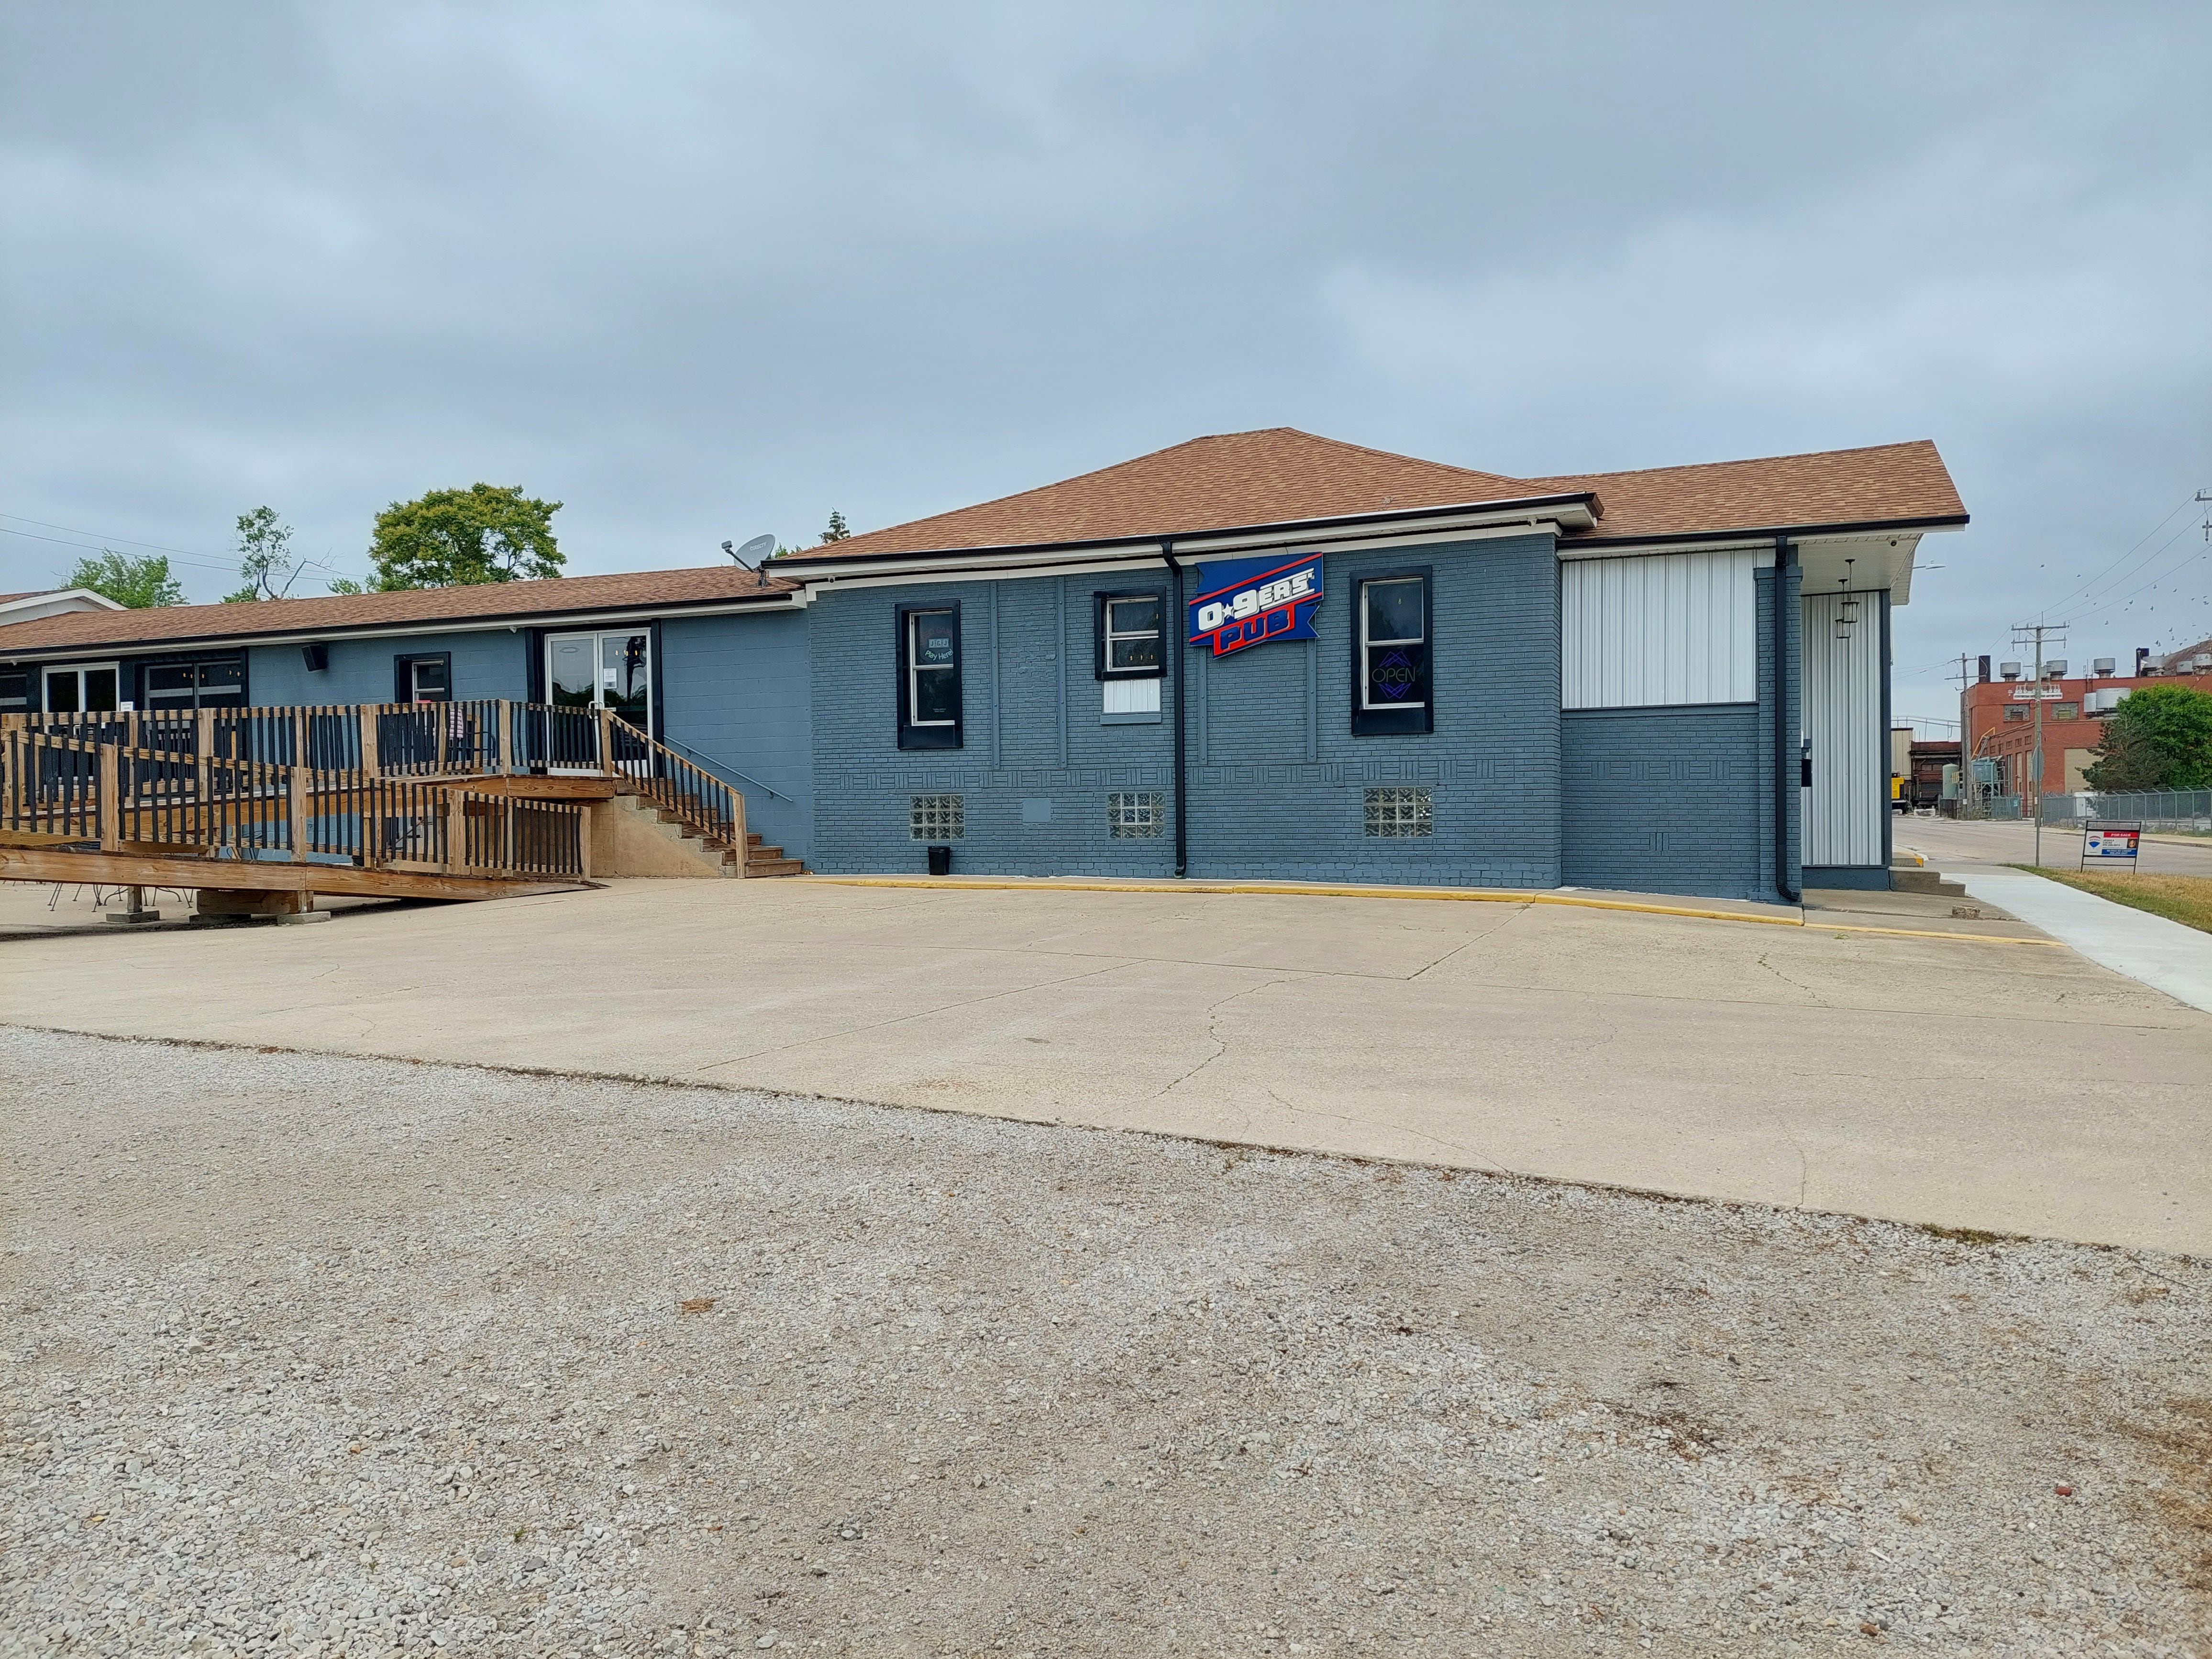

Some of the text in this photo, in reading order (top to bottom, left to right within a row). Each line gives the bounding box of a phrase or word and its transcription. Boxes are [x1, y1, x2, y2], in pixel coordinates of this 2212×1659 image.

[750, 542, 767, 551] DIRECTV
[1219, 608, 1290, 651] PUB
[925, 650, 938, 661] Play
[1371, 667, 1416, 683] OPEN
